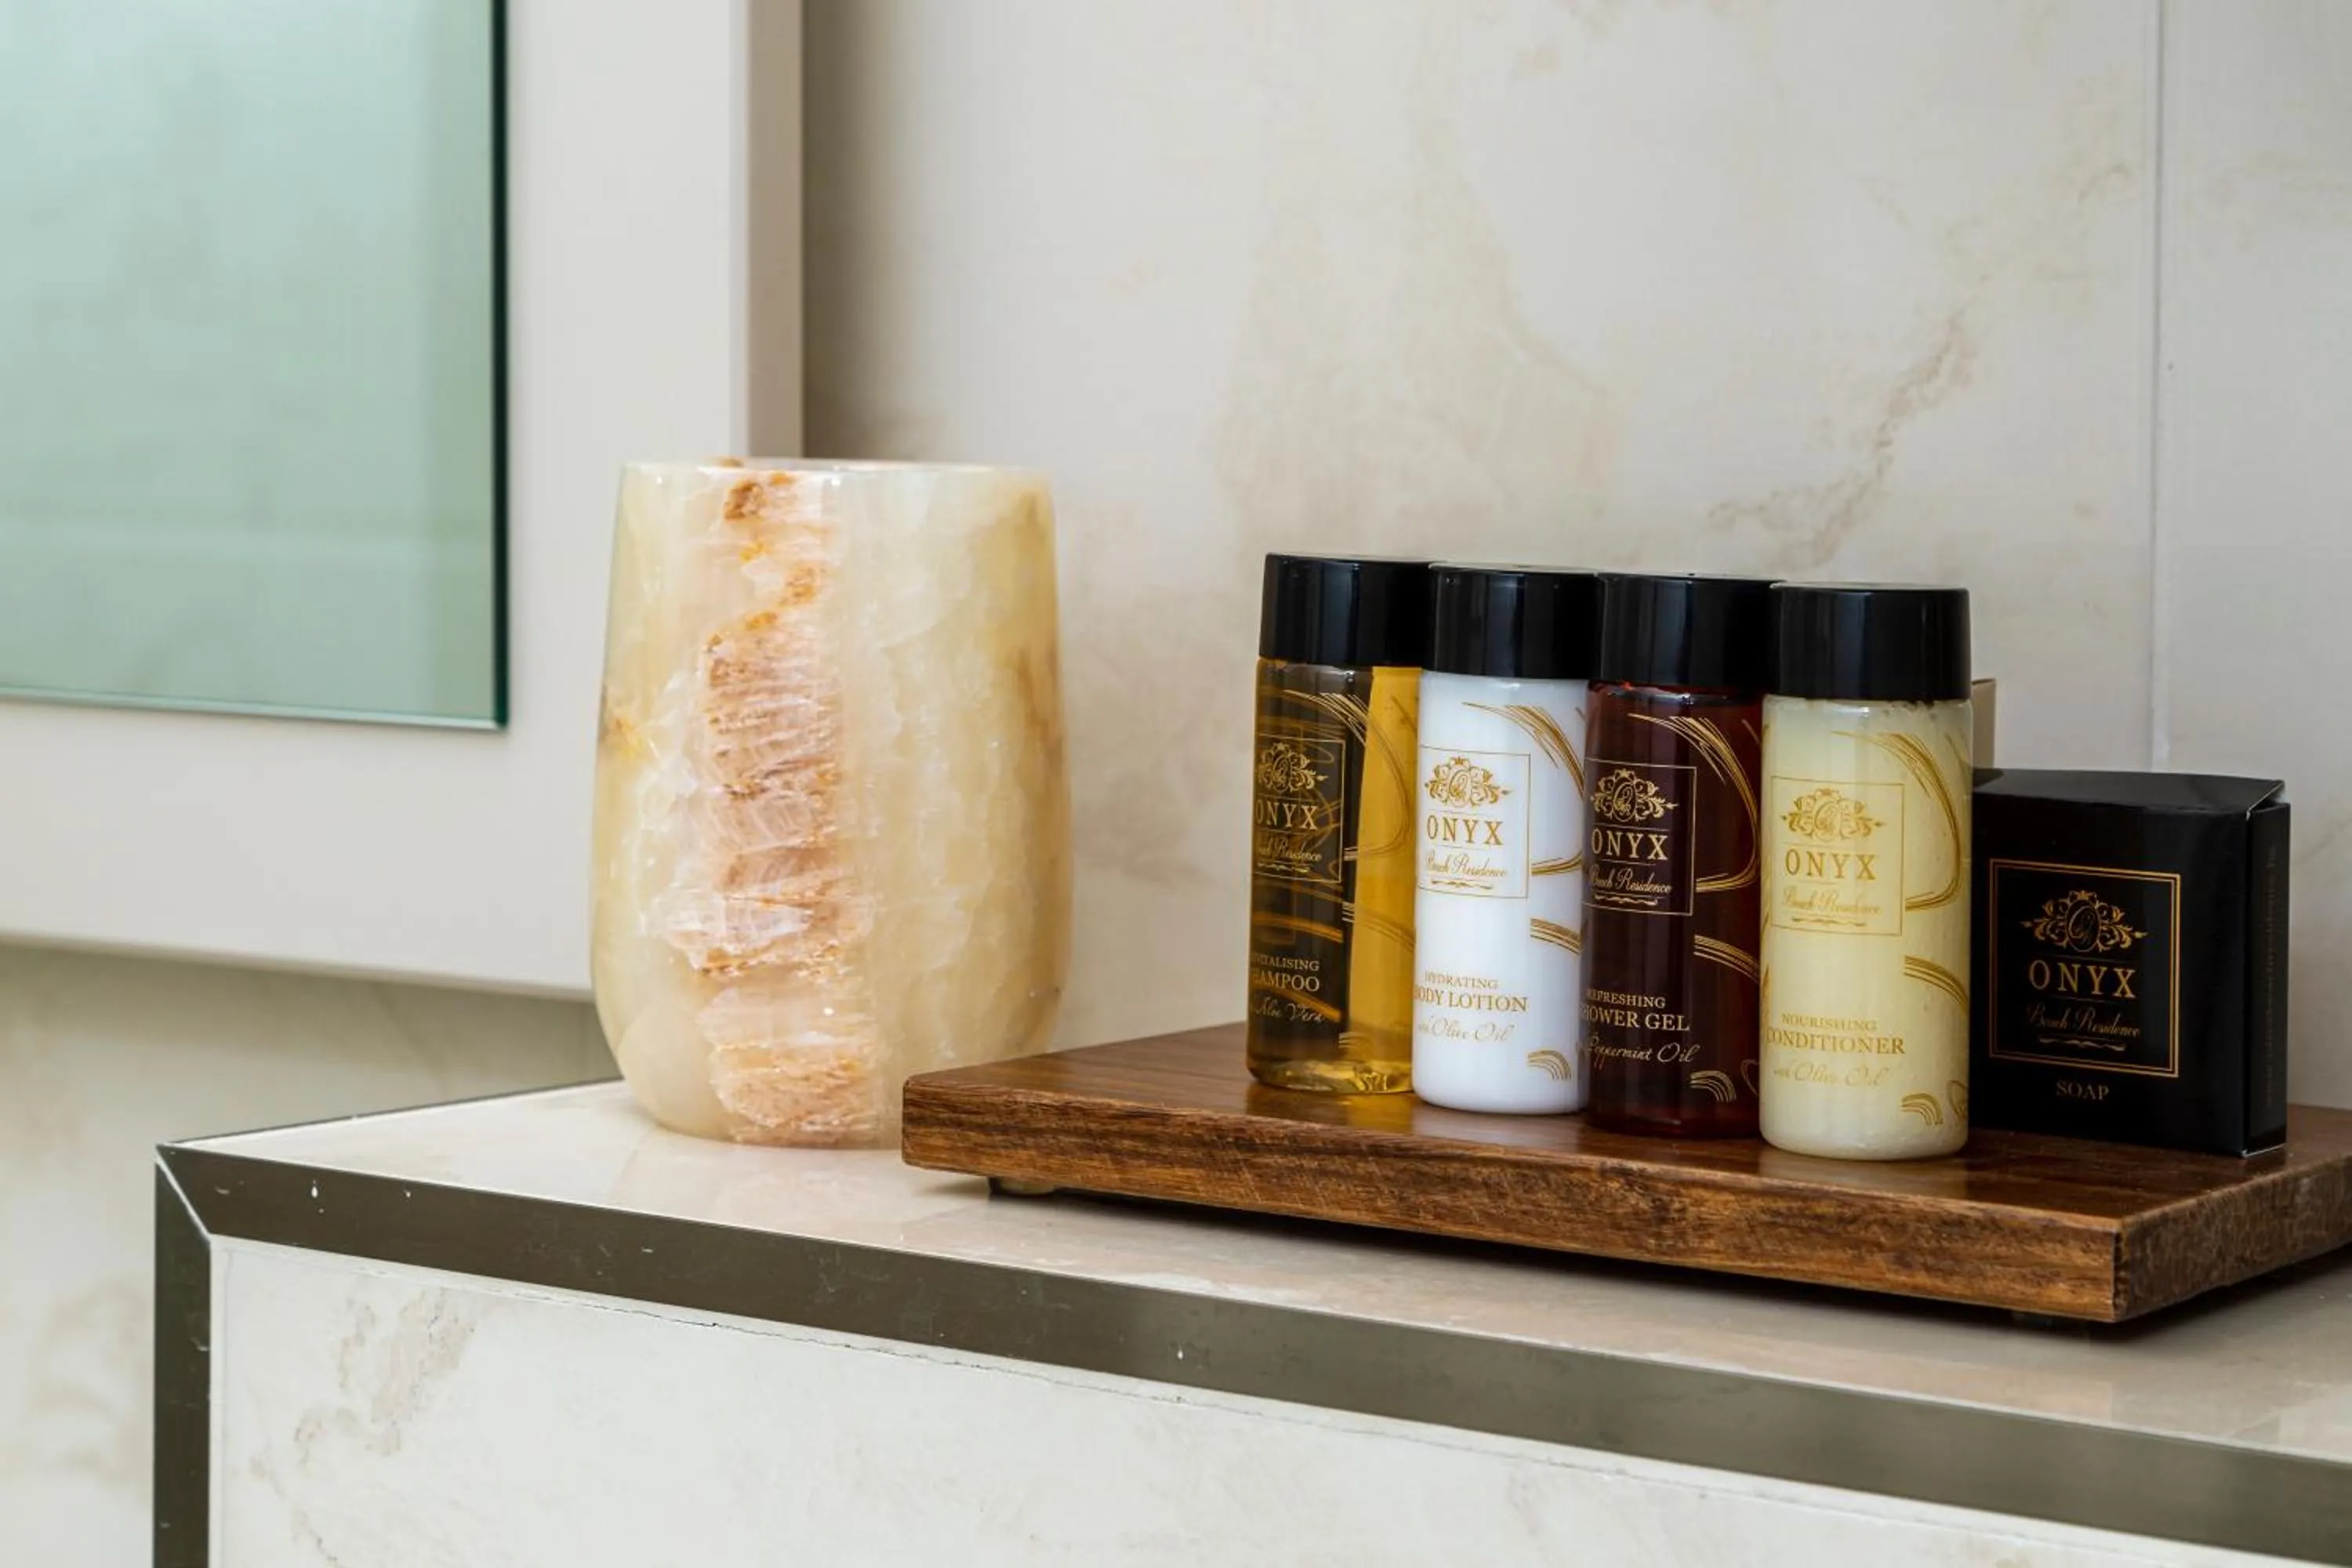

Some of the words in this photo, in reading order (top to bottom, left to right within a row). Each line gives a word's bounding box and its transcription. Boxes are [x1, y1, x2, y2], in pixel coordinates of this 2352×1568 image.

[1255, 800, 1318, 830] ONYX
[1427, 815, 1504, 846] ONYX
[1592, 828, 1668, 861] ONYX
[1785, 848, 1876, 880] ONYX
[1615, 868, 1672, 893] Residence
[1425, 971, 1498, 990] HYDRATING
[2029, 960, 2136, 999] ONYX
[1450, 992, 1528, 1013] LOTION
[1646, 1013, 1690, 1032] GEL
[1782, 1013, 1878, 1032] NOURISHING
[2074, 1007, 2140, 1037] Residence
[1657, 1042, 1700, 1063] Oil
[2056, 1081, 2109, 1101] SOAP
